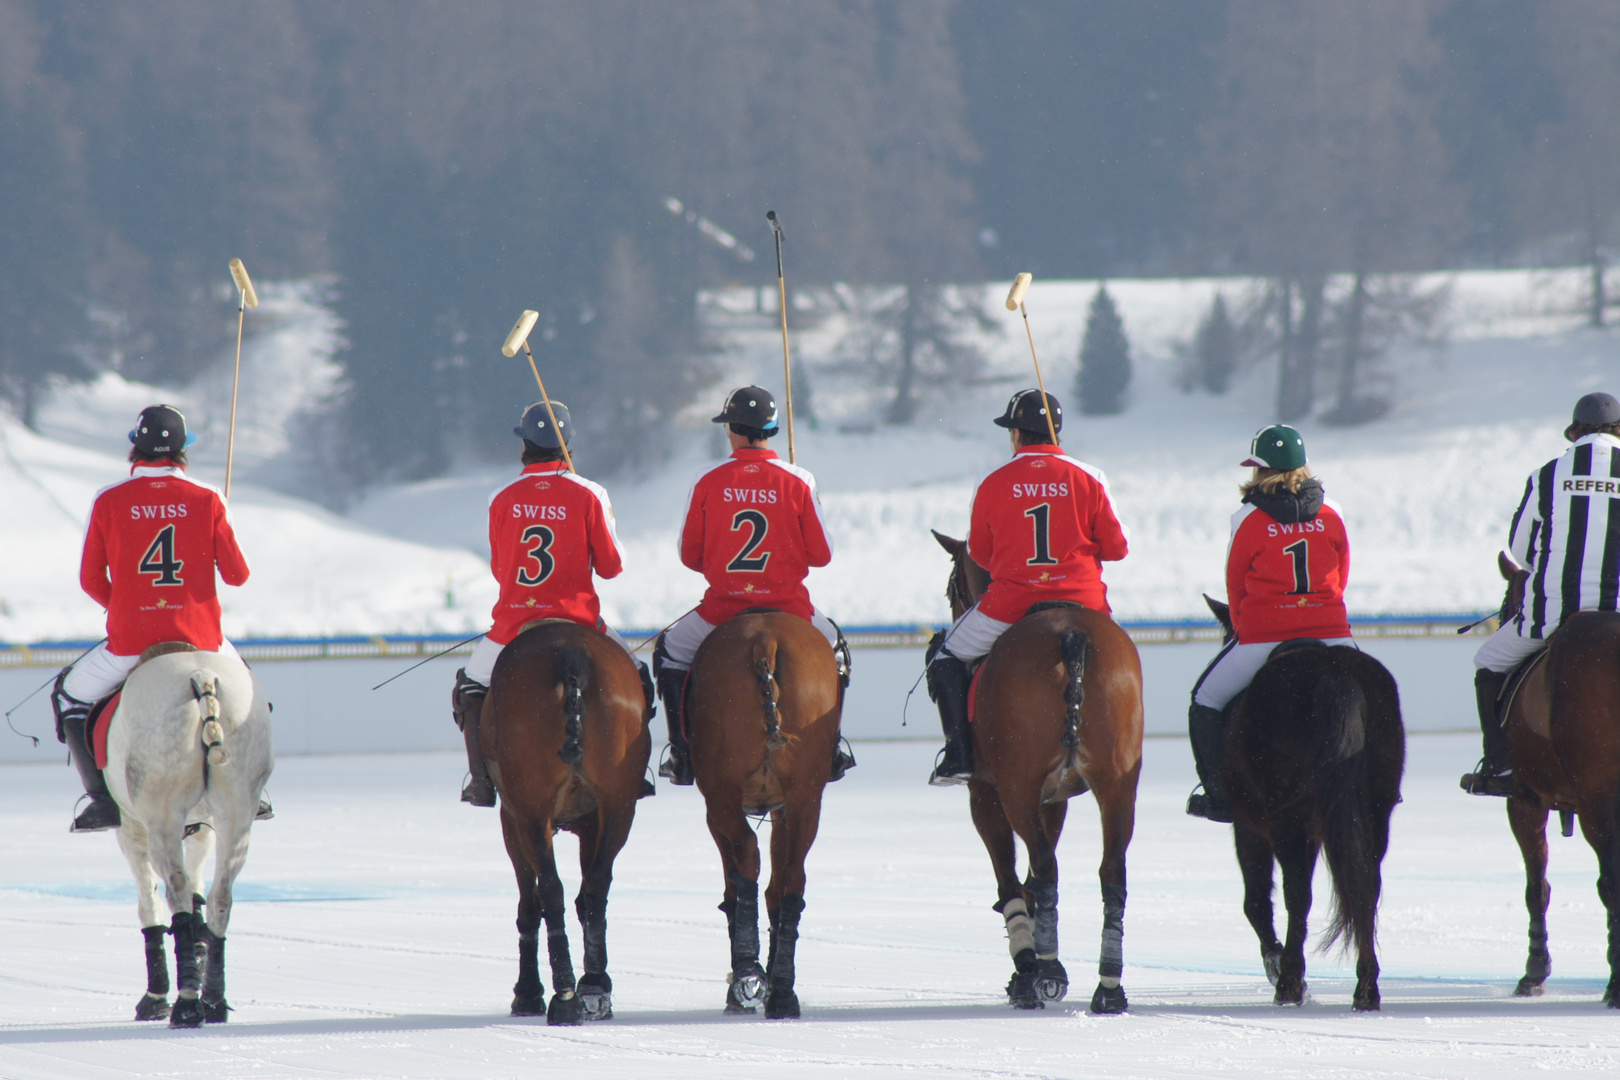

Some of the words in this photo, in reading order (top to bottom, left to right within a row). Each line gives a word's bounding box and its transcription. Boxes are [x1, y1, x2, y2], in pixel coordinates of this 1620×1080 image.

[724, 488, 776, 503] SWISS
[1013, 483, 1068, 498] SWISS
[131, 504, 187, 519] SWISS
[513, 504, 566, 520] SWISS
[1268, 519, 1324, 537] SWISS
[726, 509, 771, 572] 2
[1024, 502, 1058, 566] 1
[138, 523, 184, 587] 4
[516, 524, 555, 587] 3
[1283, 538, 1317, 595] 1
